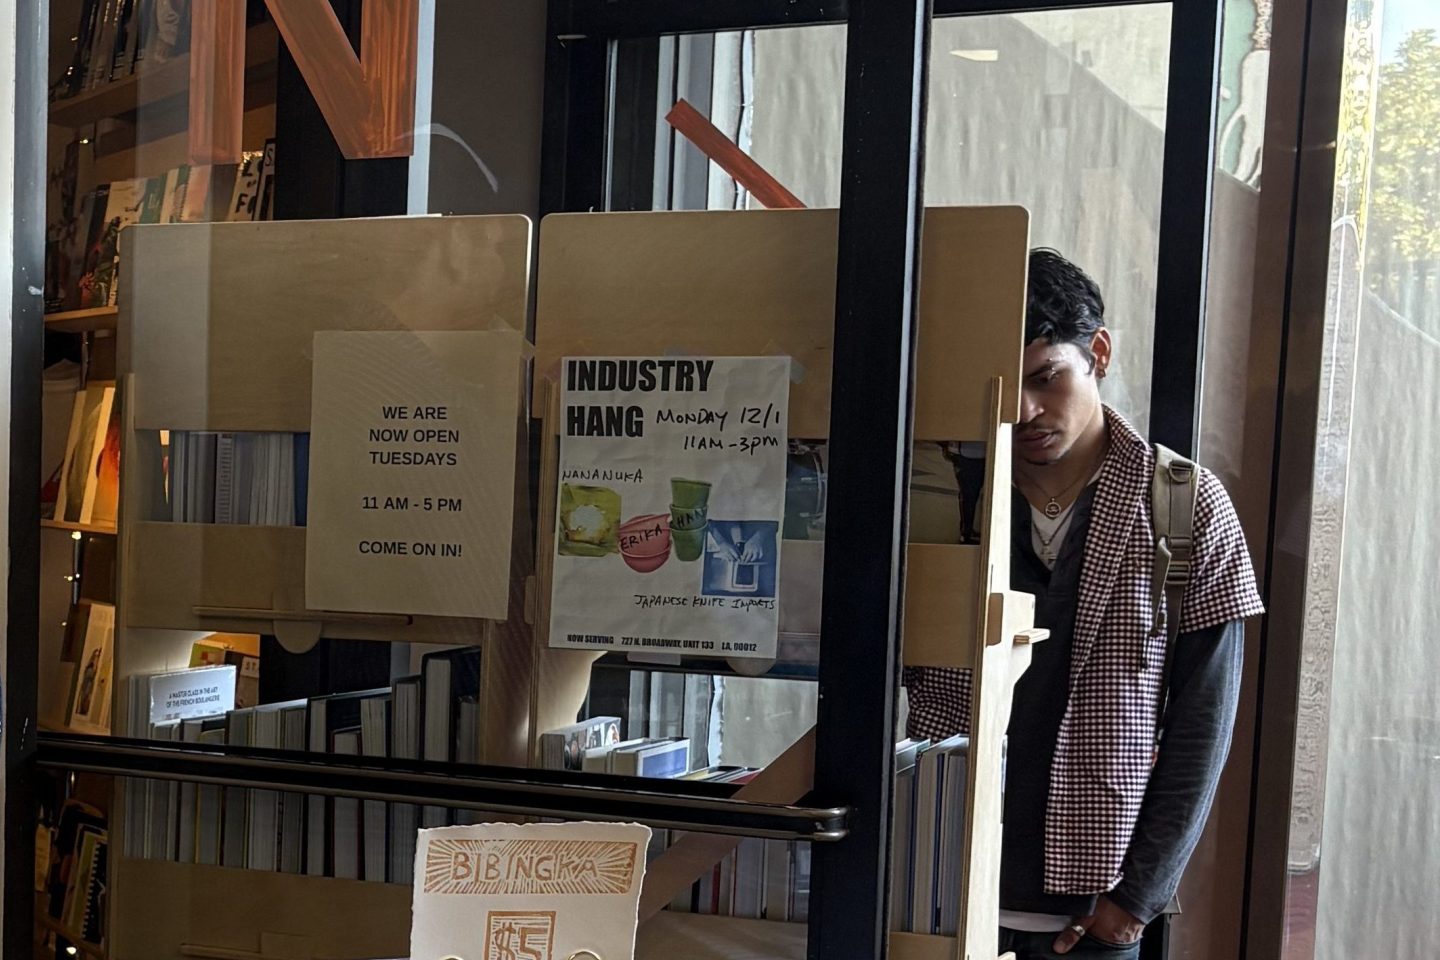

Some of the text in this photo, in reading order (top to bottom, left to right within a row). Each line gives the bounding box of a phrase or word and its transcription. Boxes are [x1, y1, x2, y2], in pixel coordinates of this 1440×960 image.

[567, 359, 714, 392] INDUSTRY
[382, 406, 448, 420] WE ARE
[740, 403, 780, 425] 12/1
[566, 405, 644, 438] HANG
[369, 429, 459, 443] NOW OPEN
[369, 452, 458, 466] TUESDAYS
[362, 497, 379, 510] 11
[383, 497, 409, 511] AM
[423, 498, 433, 511] 5
[437, 498, 462, 512] PM
[619, 524, 664, 551] ERIKA
[358, 541, 462, 557] COME ON IN!
[692, 596, 725, 608] KNIFE
[566, 634, 584, 643] NOW
[584, 635, 615, 645] SERVING
[621, 637, 634, 646] 727
[451, 850, 599, 883] BIBINGKA
